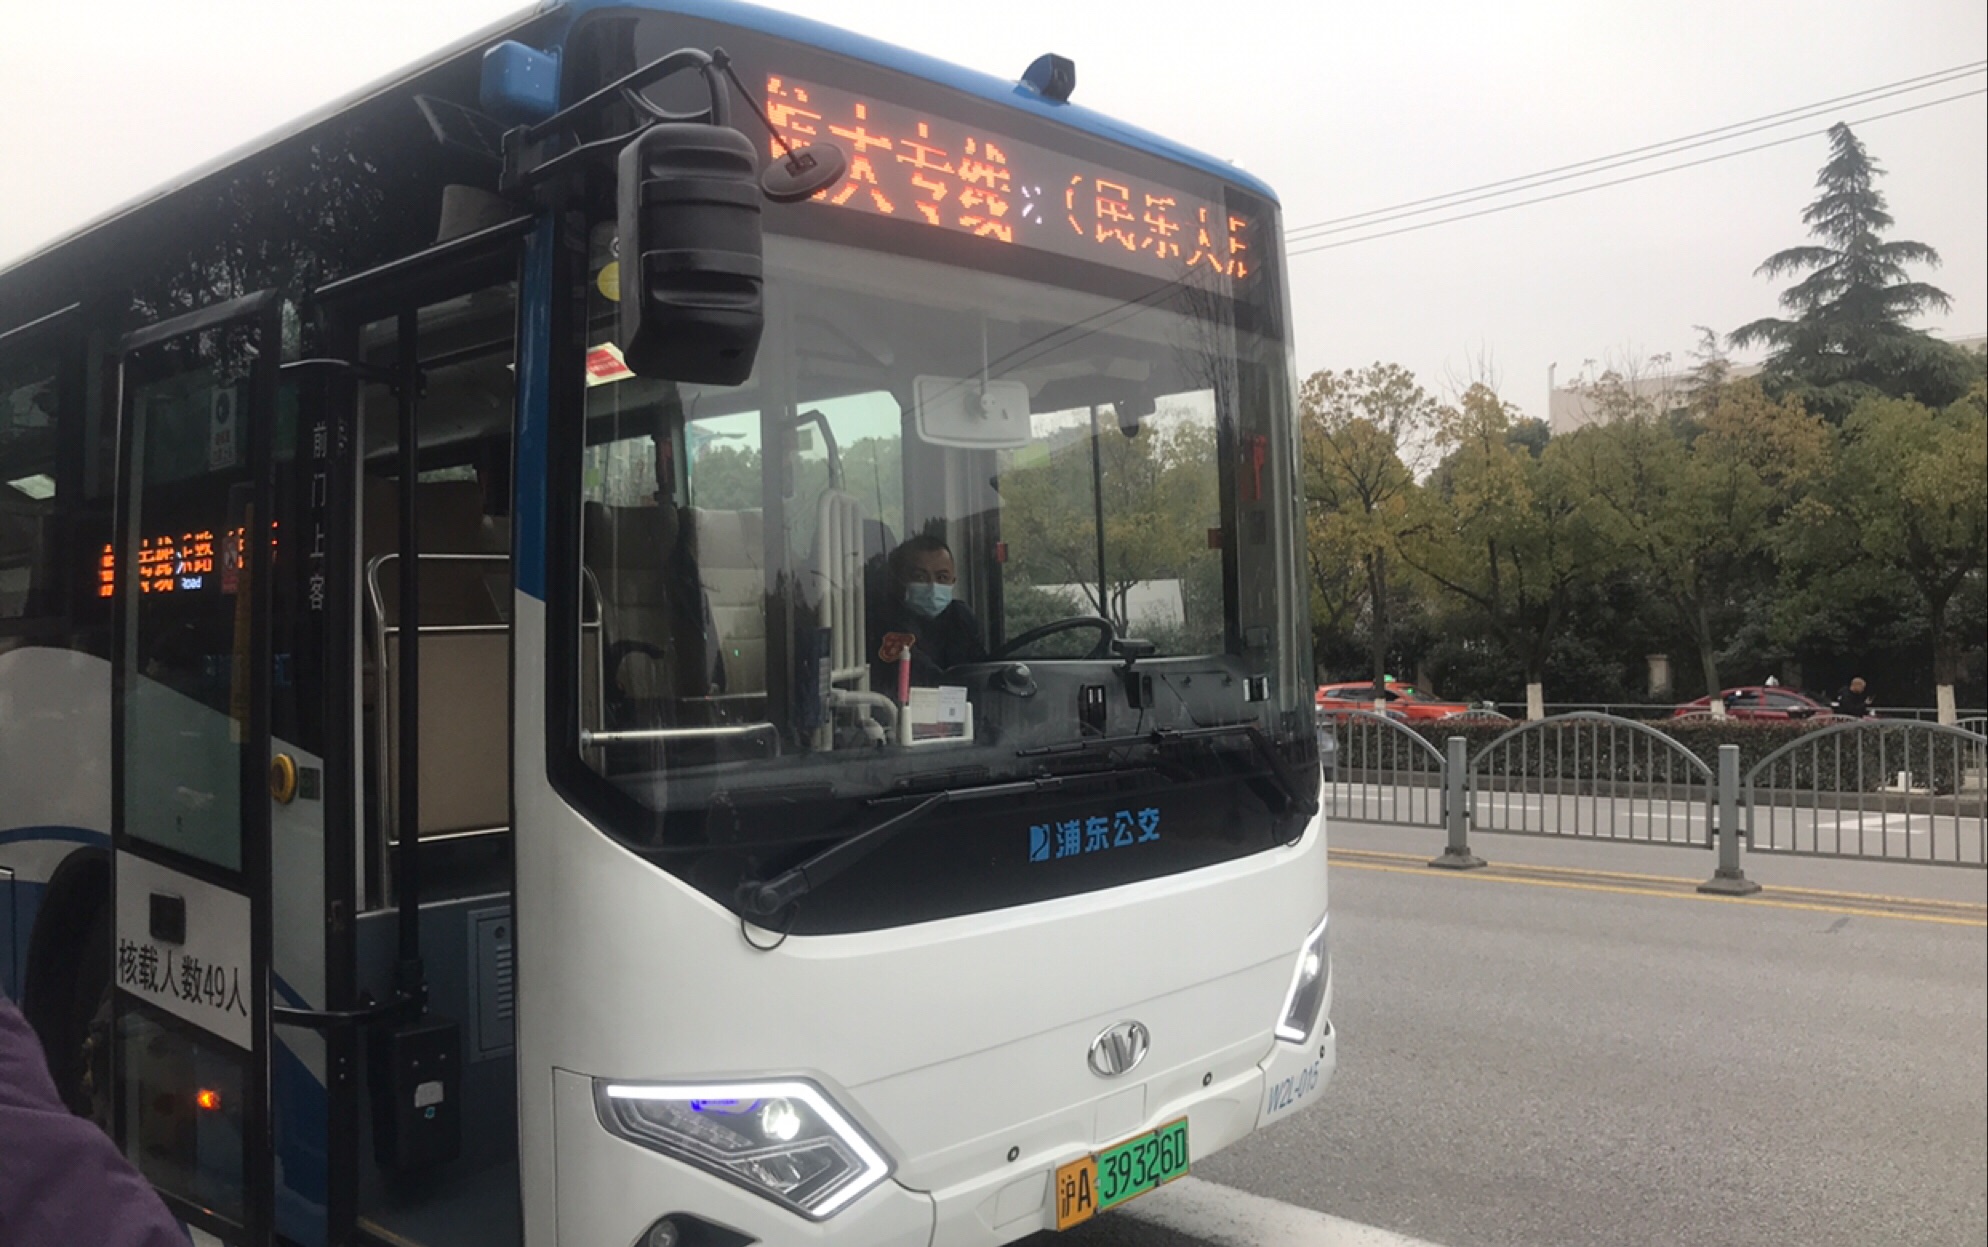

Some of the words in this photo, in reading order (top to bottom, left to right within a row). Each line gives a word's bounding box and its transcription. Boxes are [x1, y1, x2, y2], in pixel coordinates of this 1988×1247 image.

[309, 420, 327, 610] 前门上客
[1055, 807, 1161, 859] 浦东公交
[118, 938, 248, 1017] 核载人数49人
